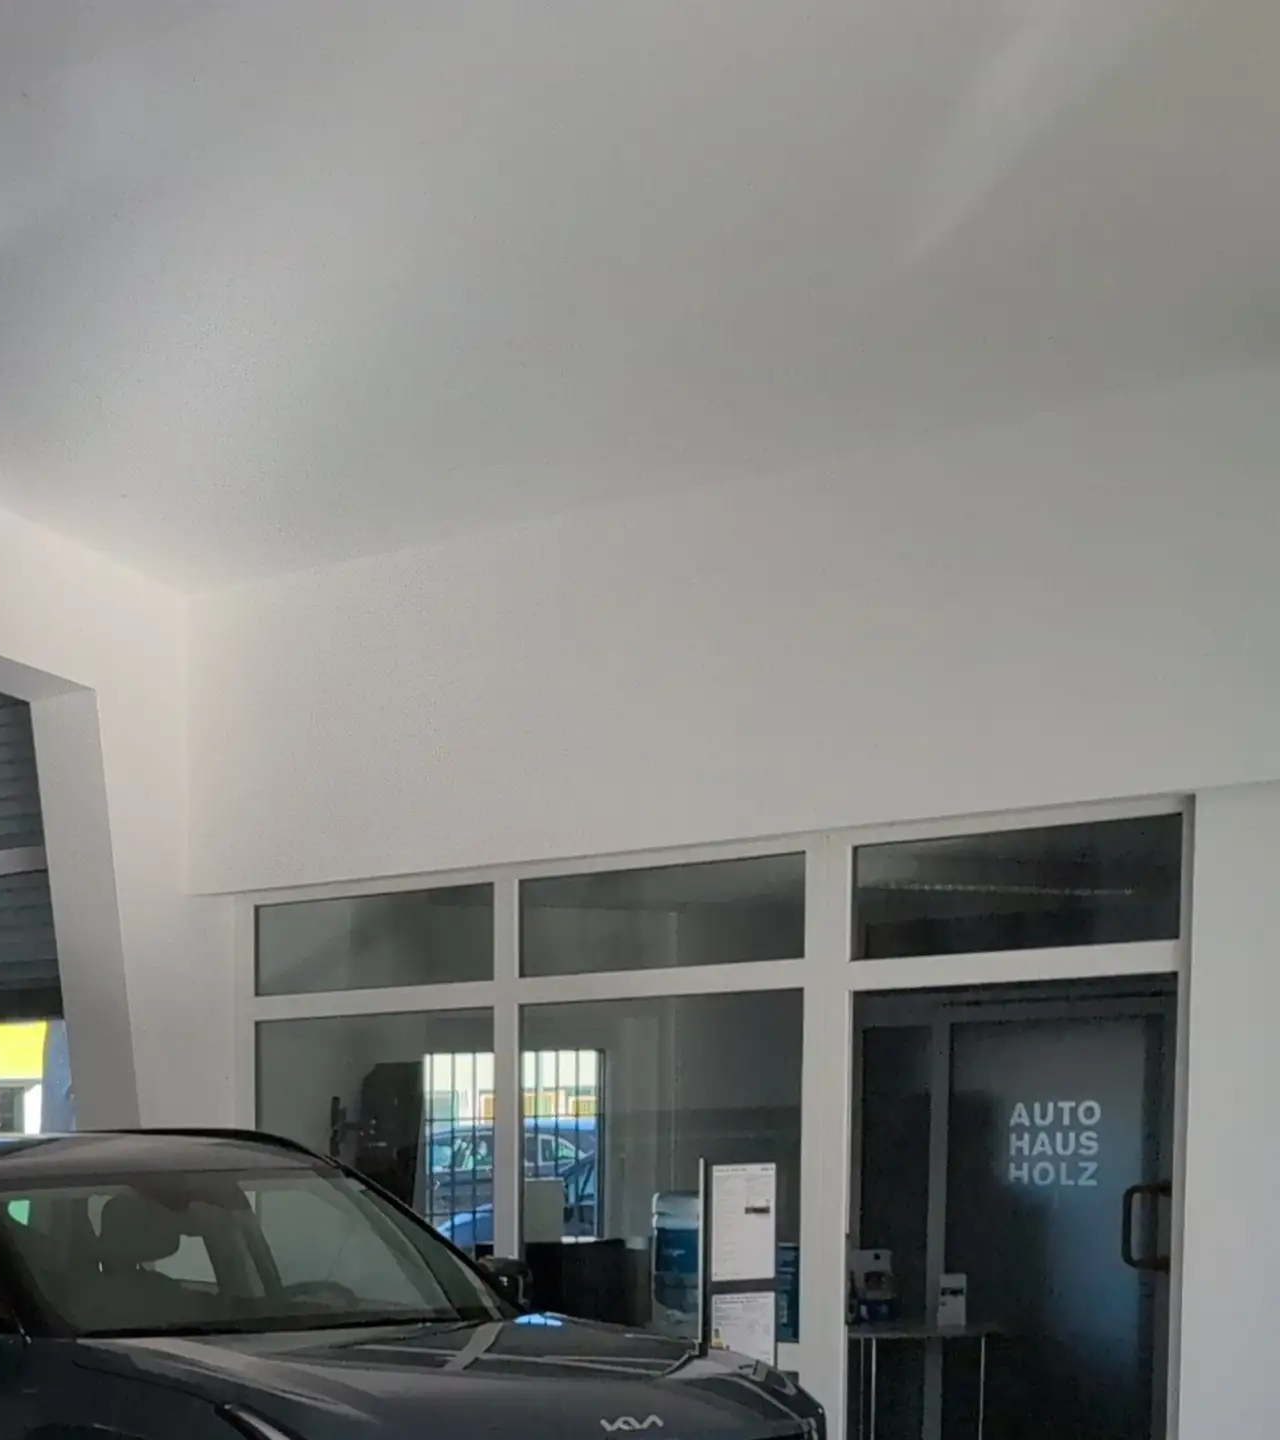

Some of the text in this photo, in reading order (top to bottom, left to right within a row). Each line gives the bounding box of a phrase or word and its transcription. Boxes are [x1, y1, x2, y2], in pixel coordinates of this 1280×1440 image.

[1009, 1100, 1101, 1128] AUTO
[1009, 1131, 1099, 1156] HAUS
[1008, 1161, 1098, 1186] HOLZ
